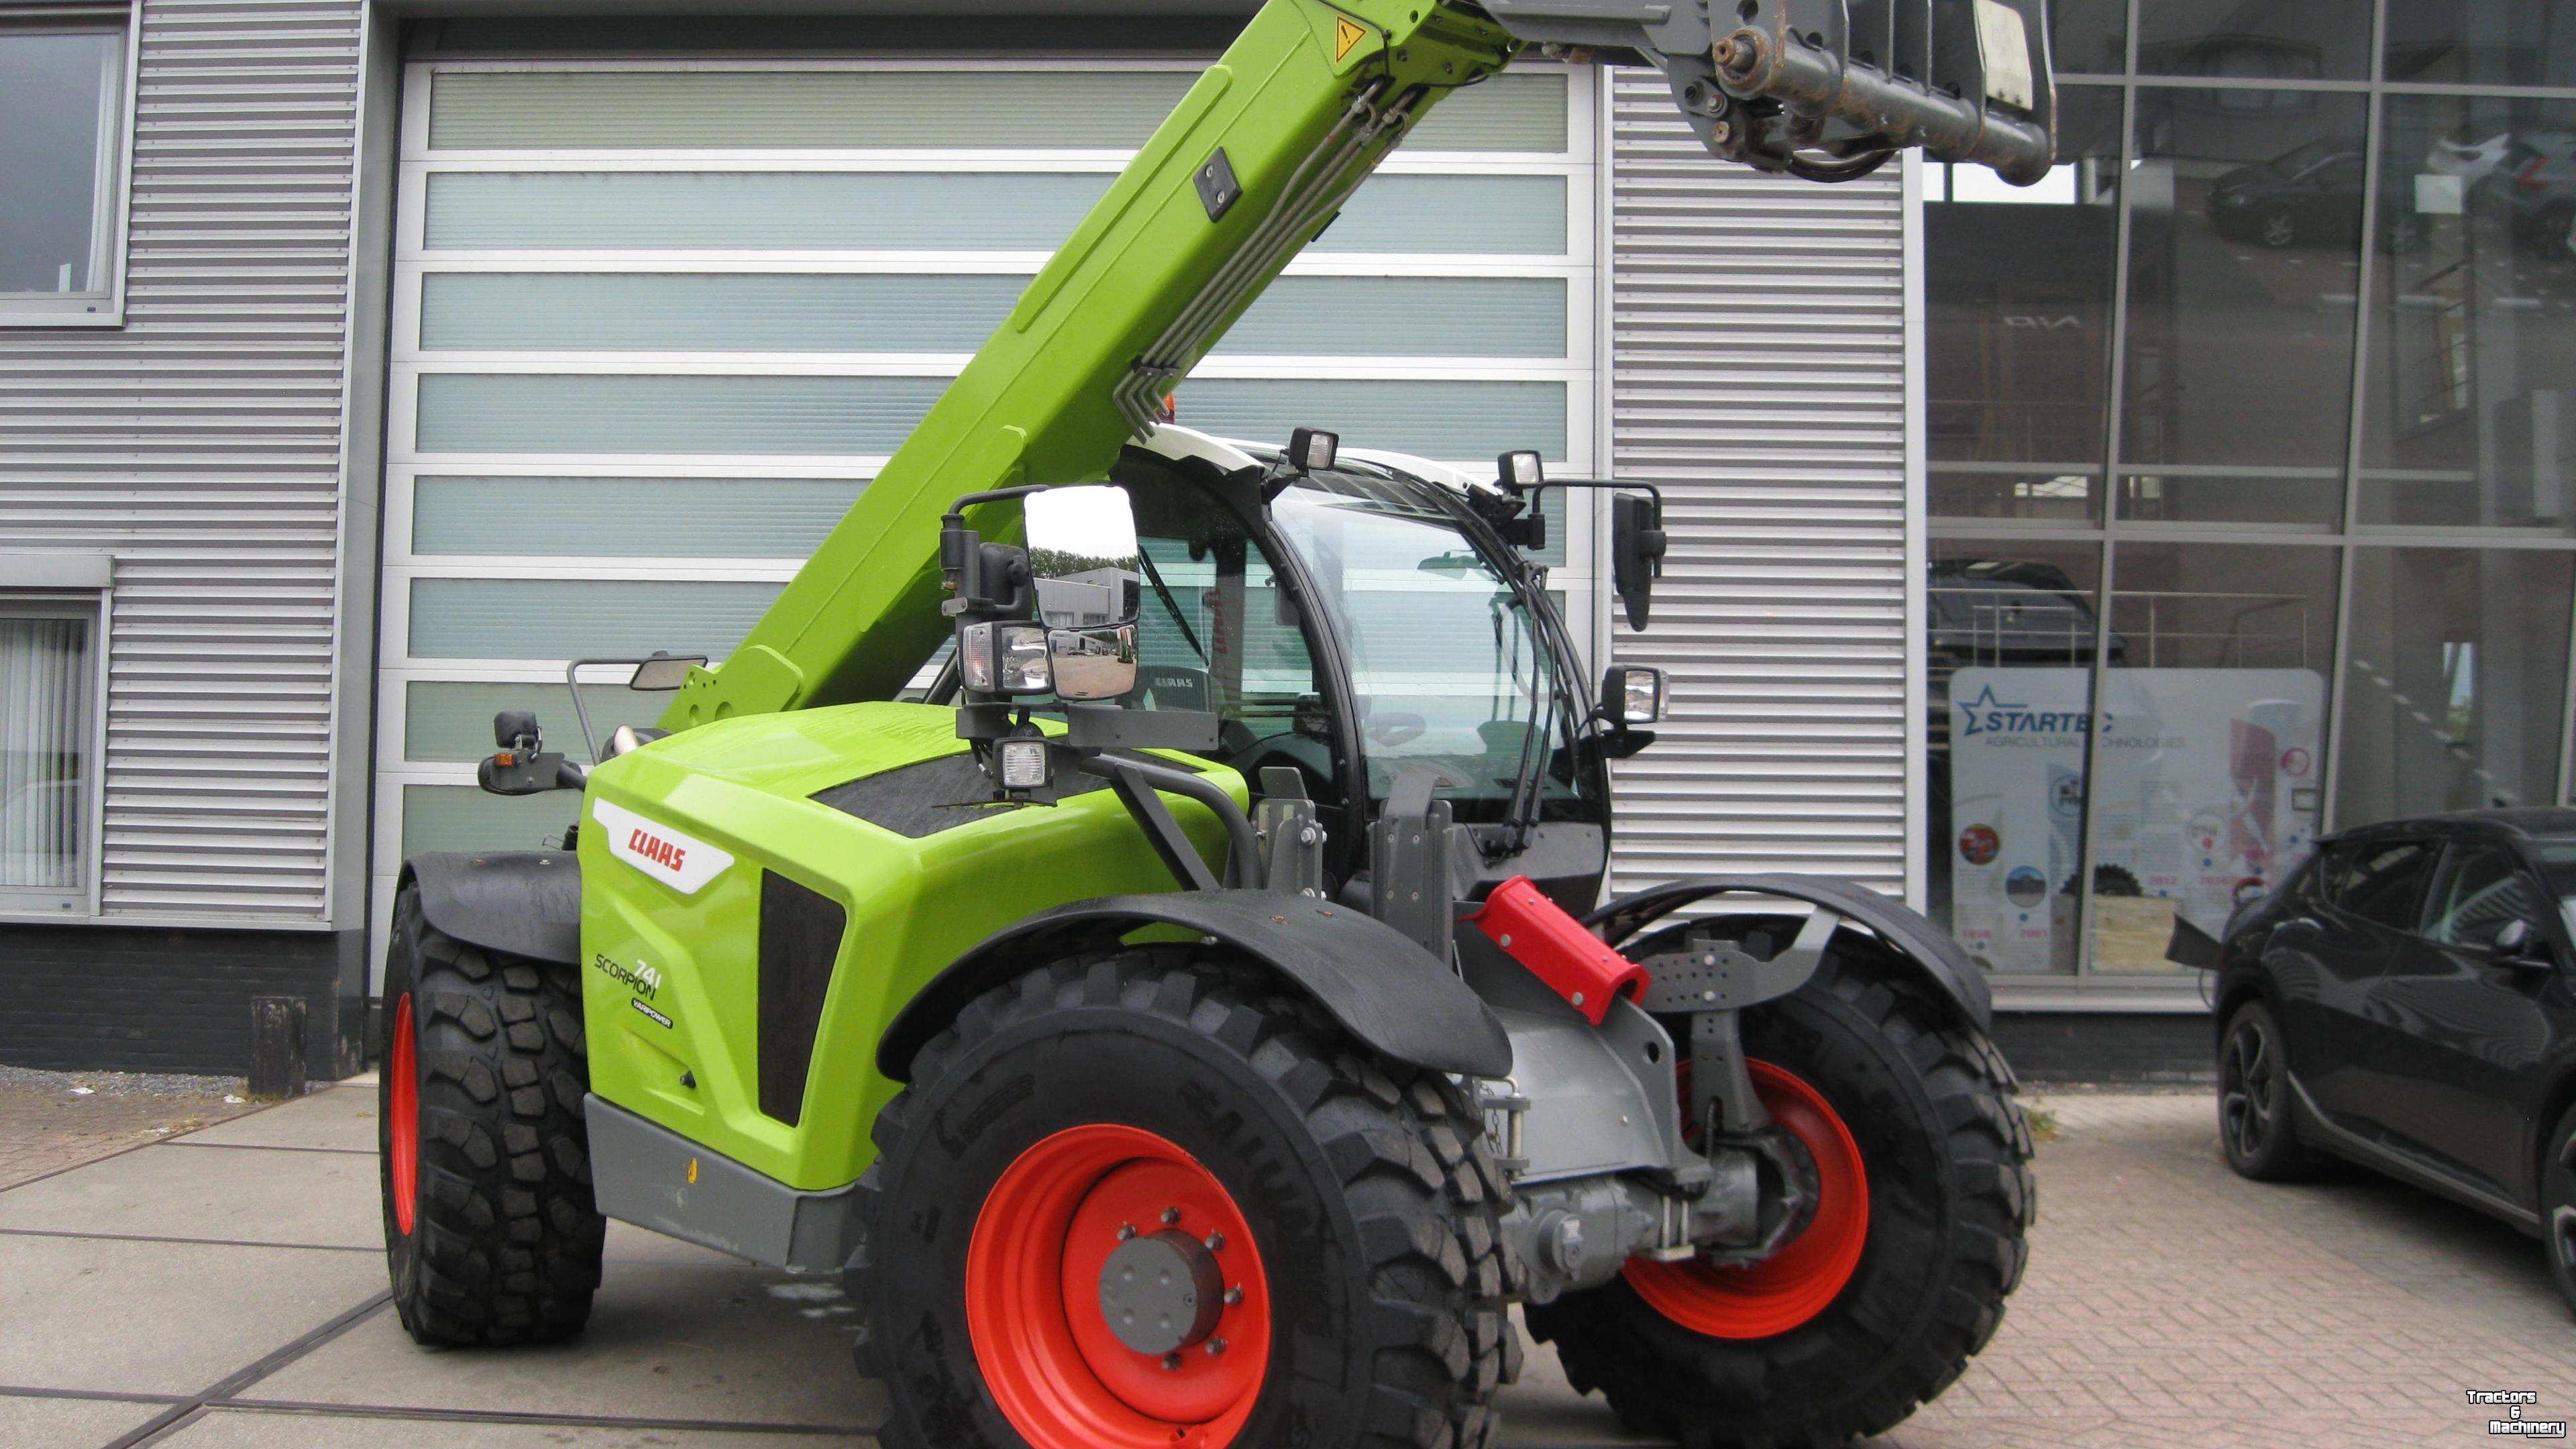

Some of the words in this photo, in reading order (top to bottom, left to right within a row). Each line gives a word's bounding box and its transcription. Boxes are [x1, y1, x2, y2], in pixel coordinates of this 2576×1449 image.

[628, 828, 686, 871] CLAAS
[594, 953, 657, 1001] SCORPION
[634, 959, 661, 989] 741
